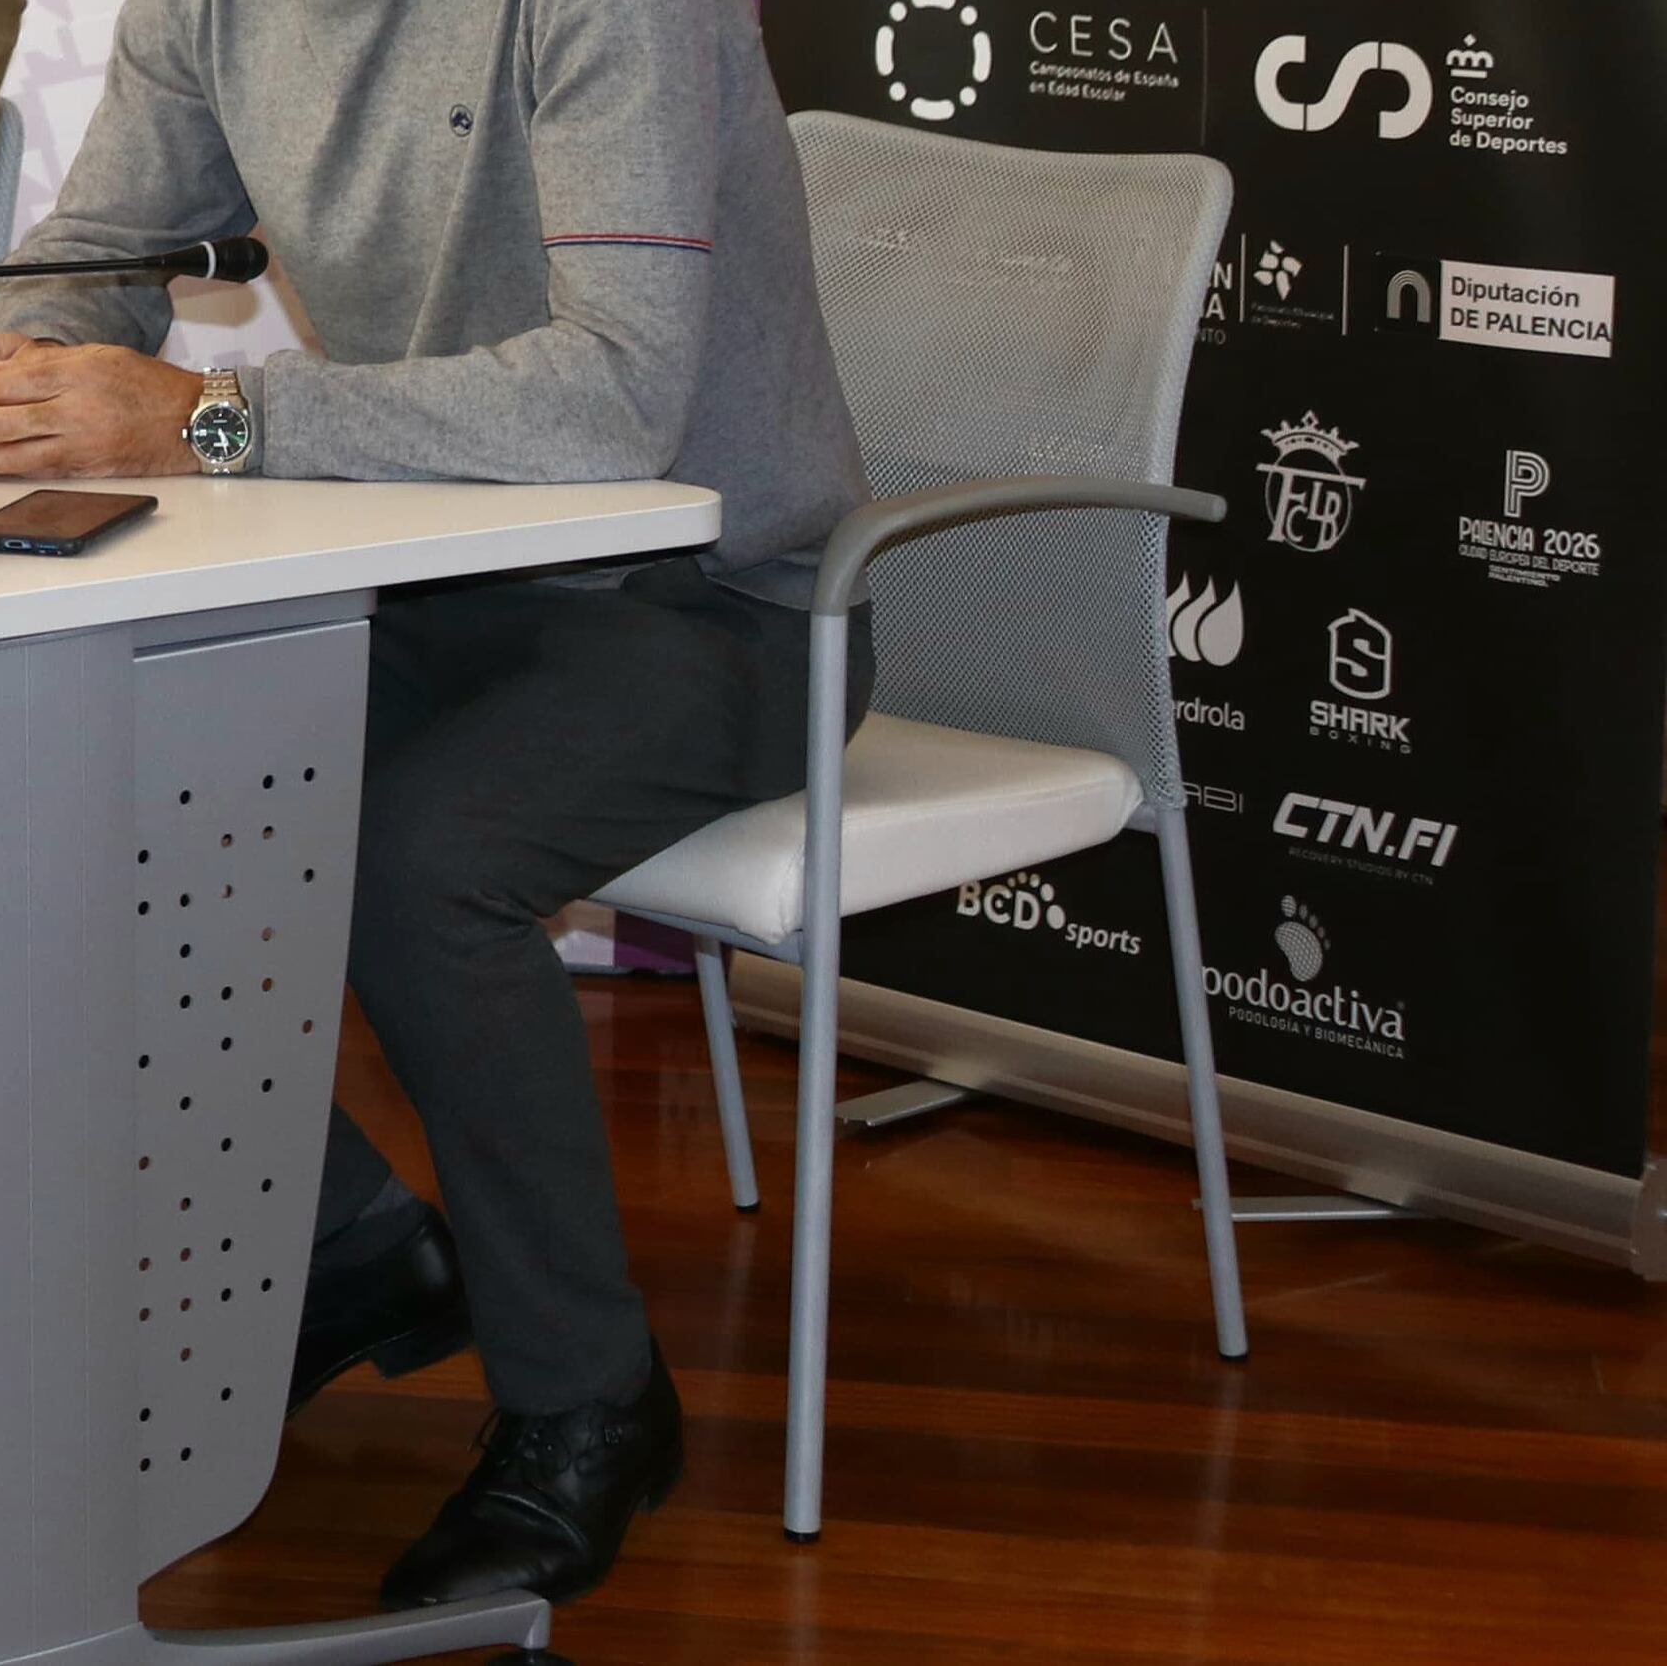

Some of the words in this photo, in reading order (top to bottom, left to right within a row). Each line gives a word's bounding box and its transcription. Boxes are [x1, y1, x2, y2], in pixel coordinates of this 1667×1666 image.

[1030, 11, 1178, 64] CESA
[1029, 81, 1046, 94] en
[1048, 80, 1080, 98] Edad
[1114, 69, 1131, 84] de
[1451, 86, 1530, 110] Consejo
[1451, 108, 1535, 131] Superior
[1449, 130, 1472, 148] de
[1476, 131, 1568, 155] Deportes
[1451, 276, 1580, 307] Diputación
[1451, 307, 1479, 329] DE
[1486, 312, 1612, 342] PALENCIA
[1458, 515, 1535, 552] PALENCIA
[1543, 528, 1601, 560] 2026
[1309, 699, 1411, 744] SHARK
[1309, 725, 1412, 755] BOXING
[1273, 792, 1458, 867] CTN.FI
[957, 879, 1040, 931] BCD
[1065, 919, 1142, 956] sports
[1202, 965, 1404, 1041] podoactiva
